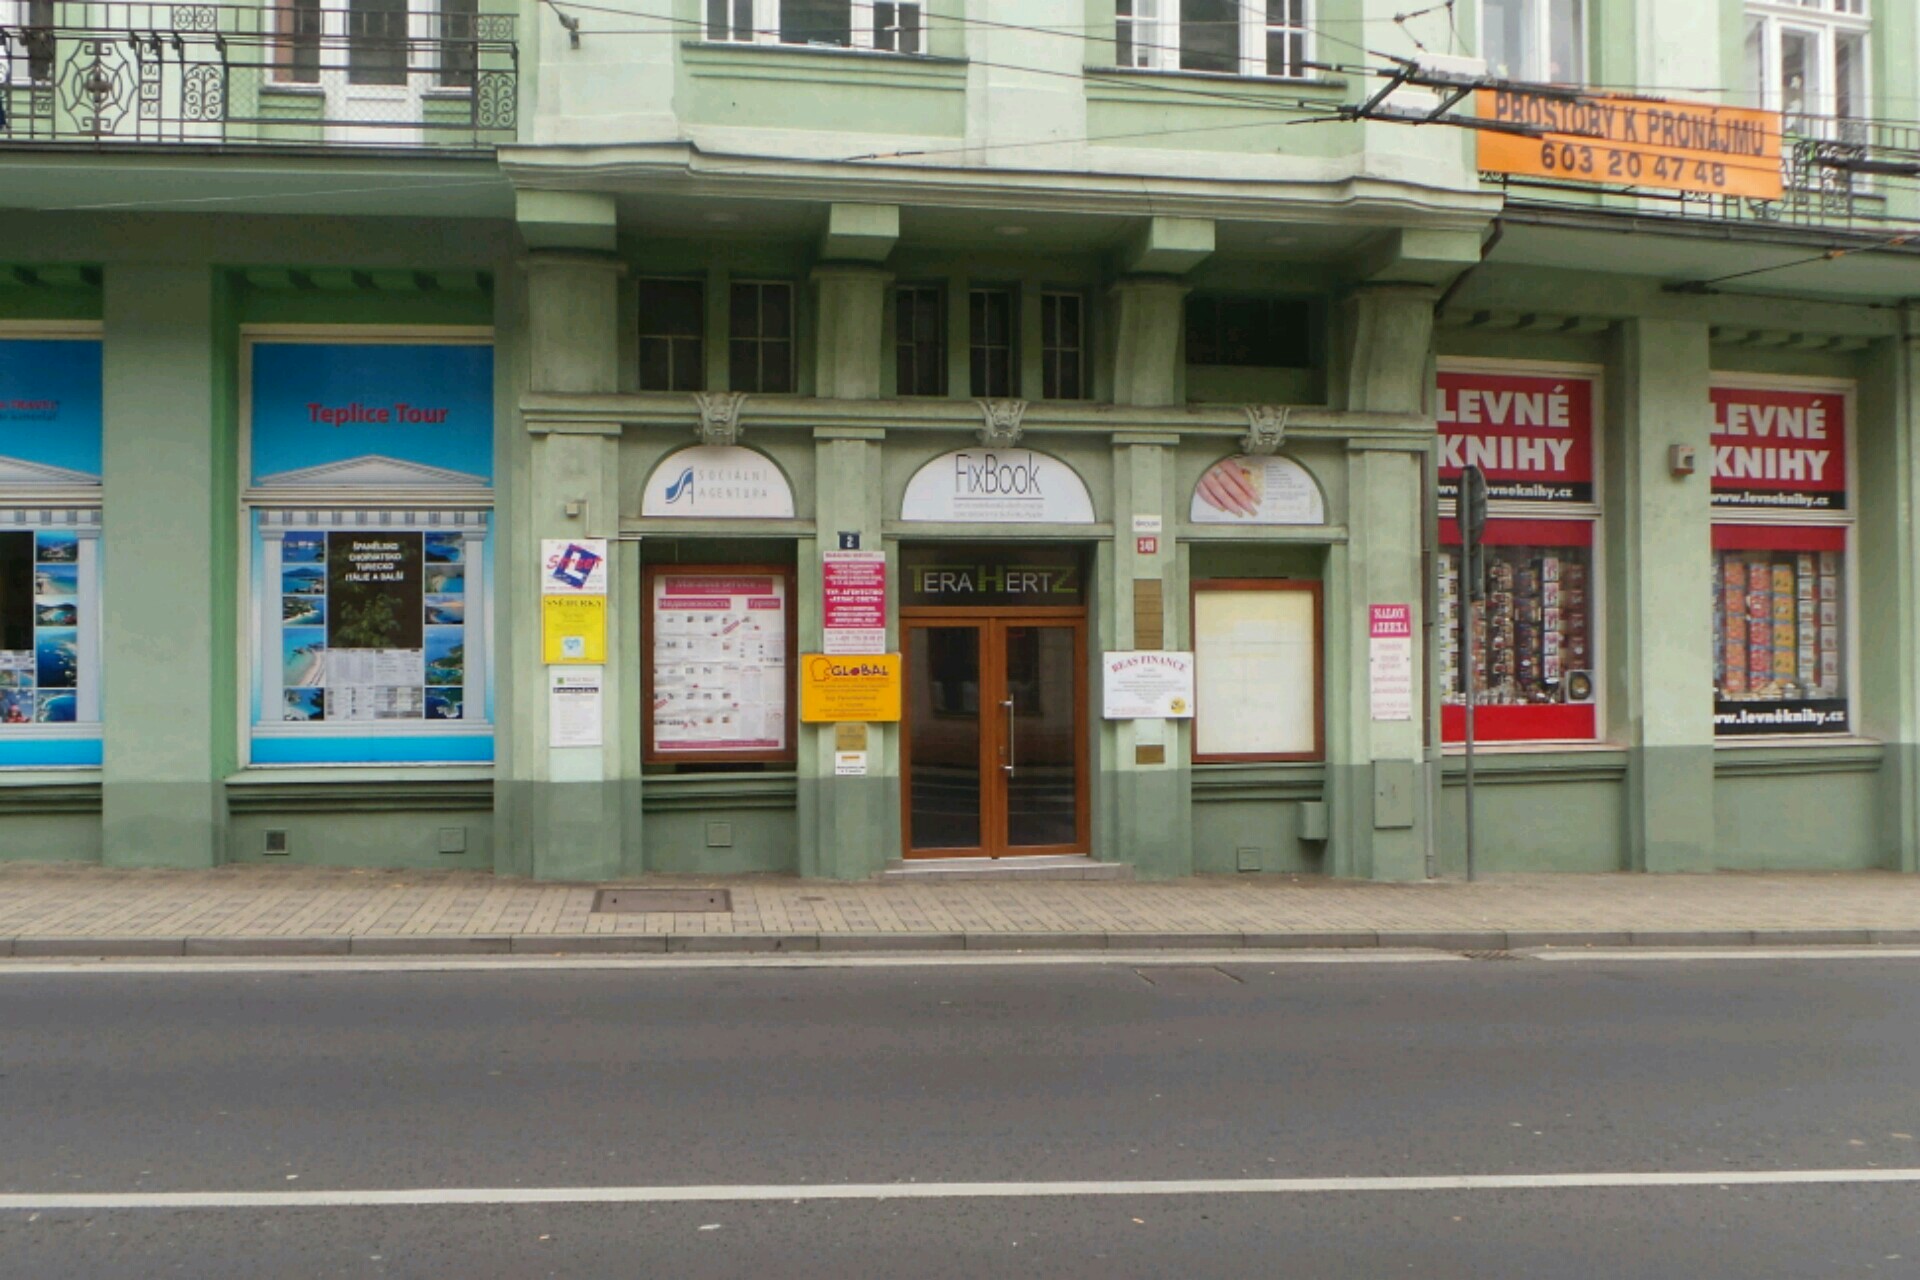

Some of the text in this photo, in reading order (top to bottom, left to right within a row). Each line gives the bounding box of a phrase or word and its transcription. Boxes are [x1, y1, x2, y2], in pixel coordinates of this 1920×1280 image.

[1495, 88, 1765, 156] PROSTORY K PRONÁJMU
[1541, 142, 1726, 187] 603 20 47 48
[307, 402, 448, 428] Teplice Tour
[1437, 384, 1570, 427] LEVNÉ
[1710, 400, 1826, 439] LEVNÉ
[1438, 434, 1573, 471] KNIHY
[1711, 446, 1830, 481] KNIHY
[956, 453, 1041, 494] FixBook
[700, 487, 768, 499] AGENTURA
[846, 534, 855, 548] 2
[907, 565, 974, 593] TERA
[977, 565, 1077, 593] HERTZ
[831, 664, 889, 676] GLOBAL
